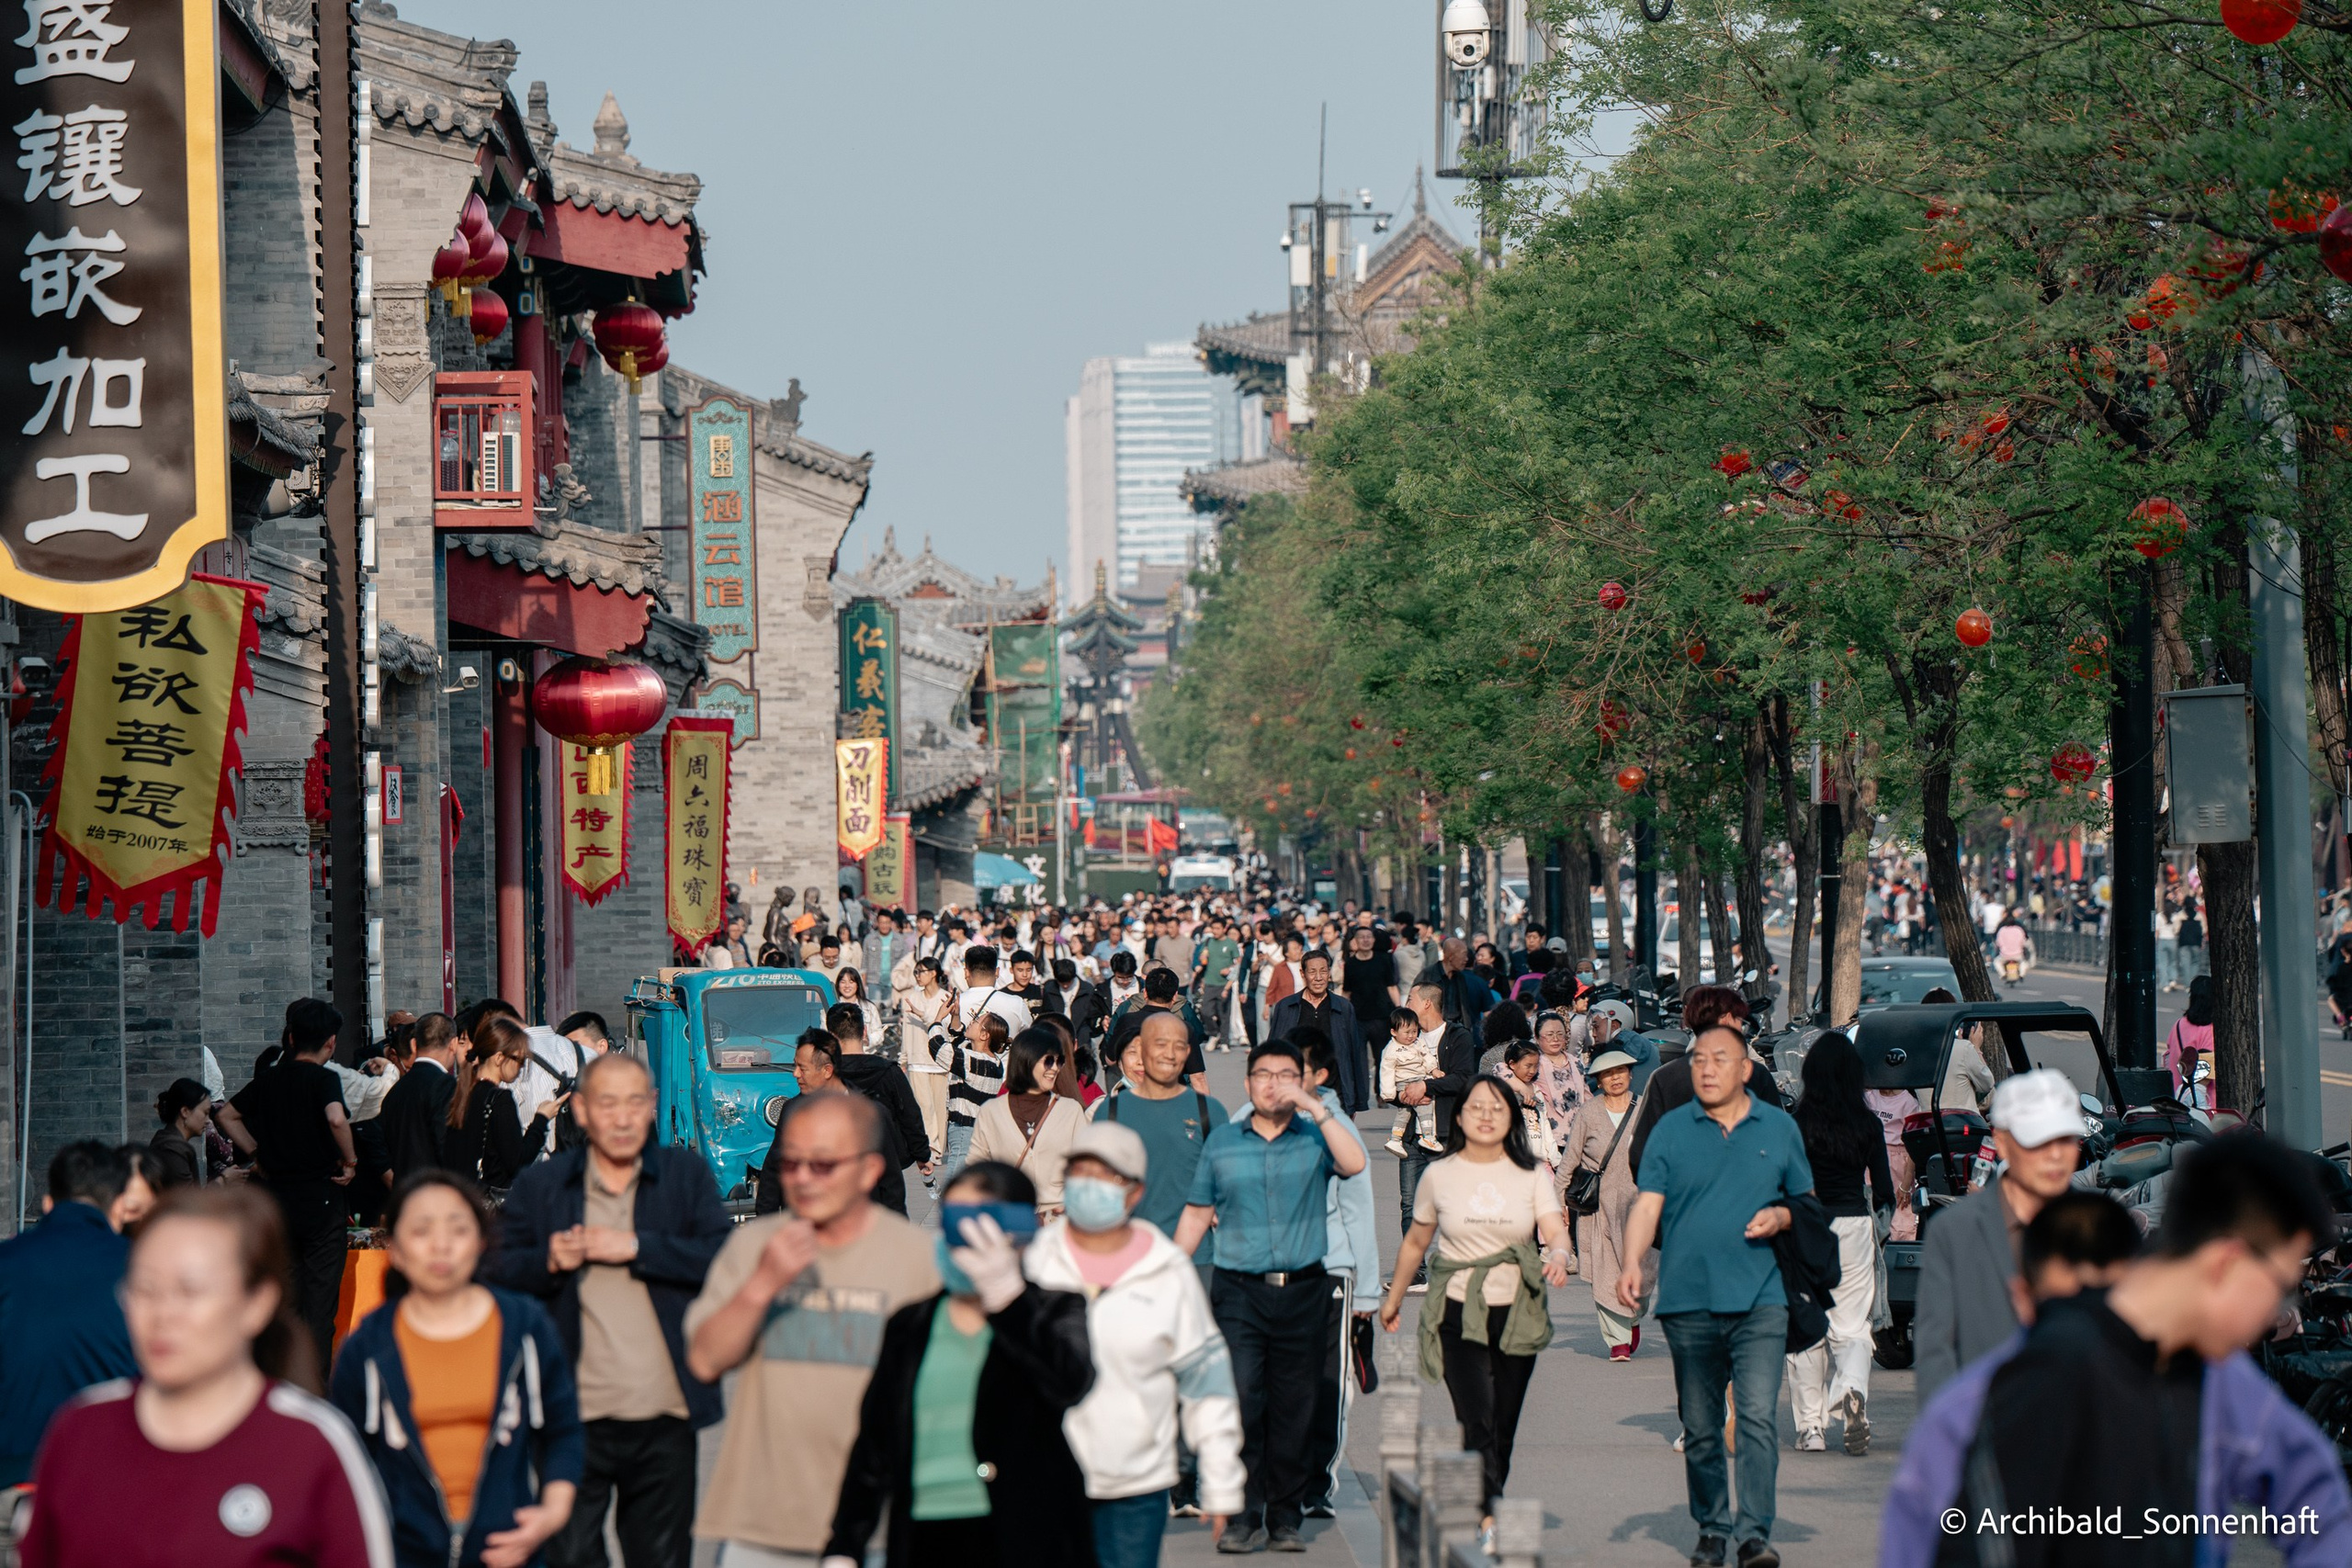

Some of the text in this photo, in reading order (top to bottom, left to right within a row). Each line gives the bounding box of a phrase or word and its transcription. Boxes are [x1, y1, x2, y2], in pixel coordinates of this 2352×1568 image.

[12, 0, 150, 544] 盛镶嵌加工
[702, 490, 745, 608] 涵云馆
[94, 606, 209, 829] 私欲菩提
[86, 824, 189, 854] 始于2007年
[682, 754, 712, 907] 周六福珠寶
[844, 747, 873, 835] 刀削面
